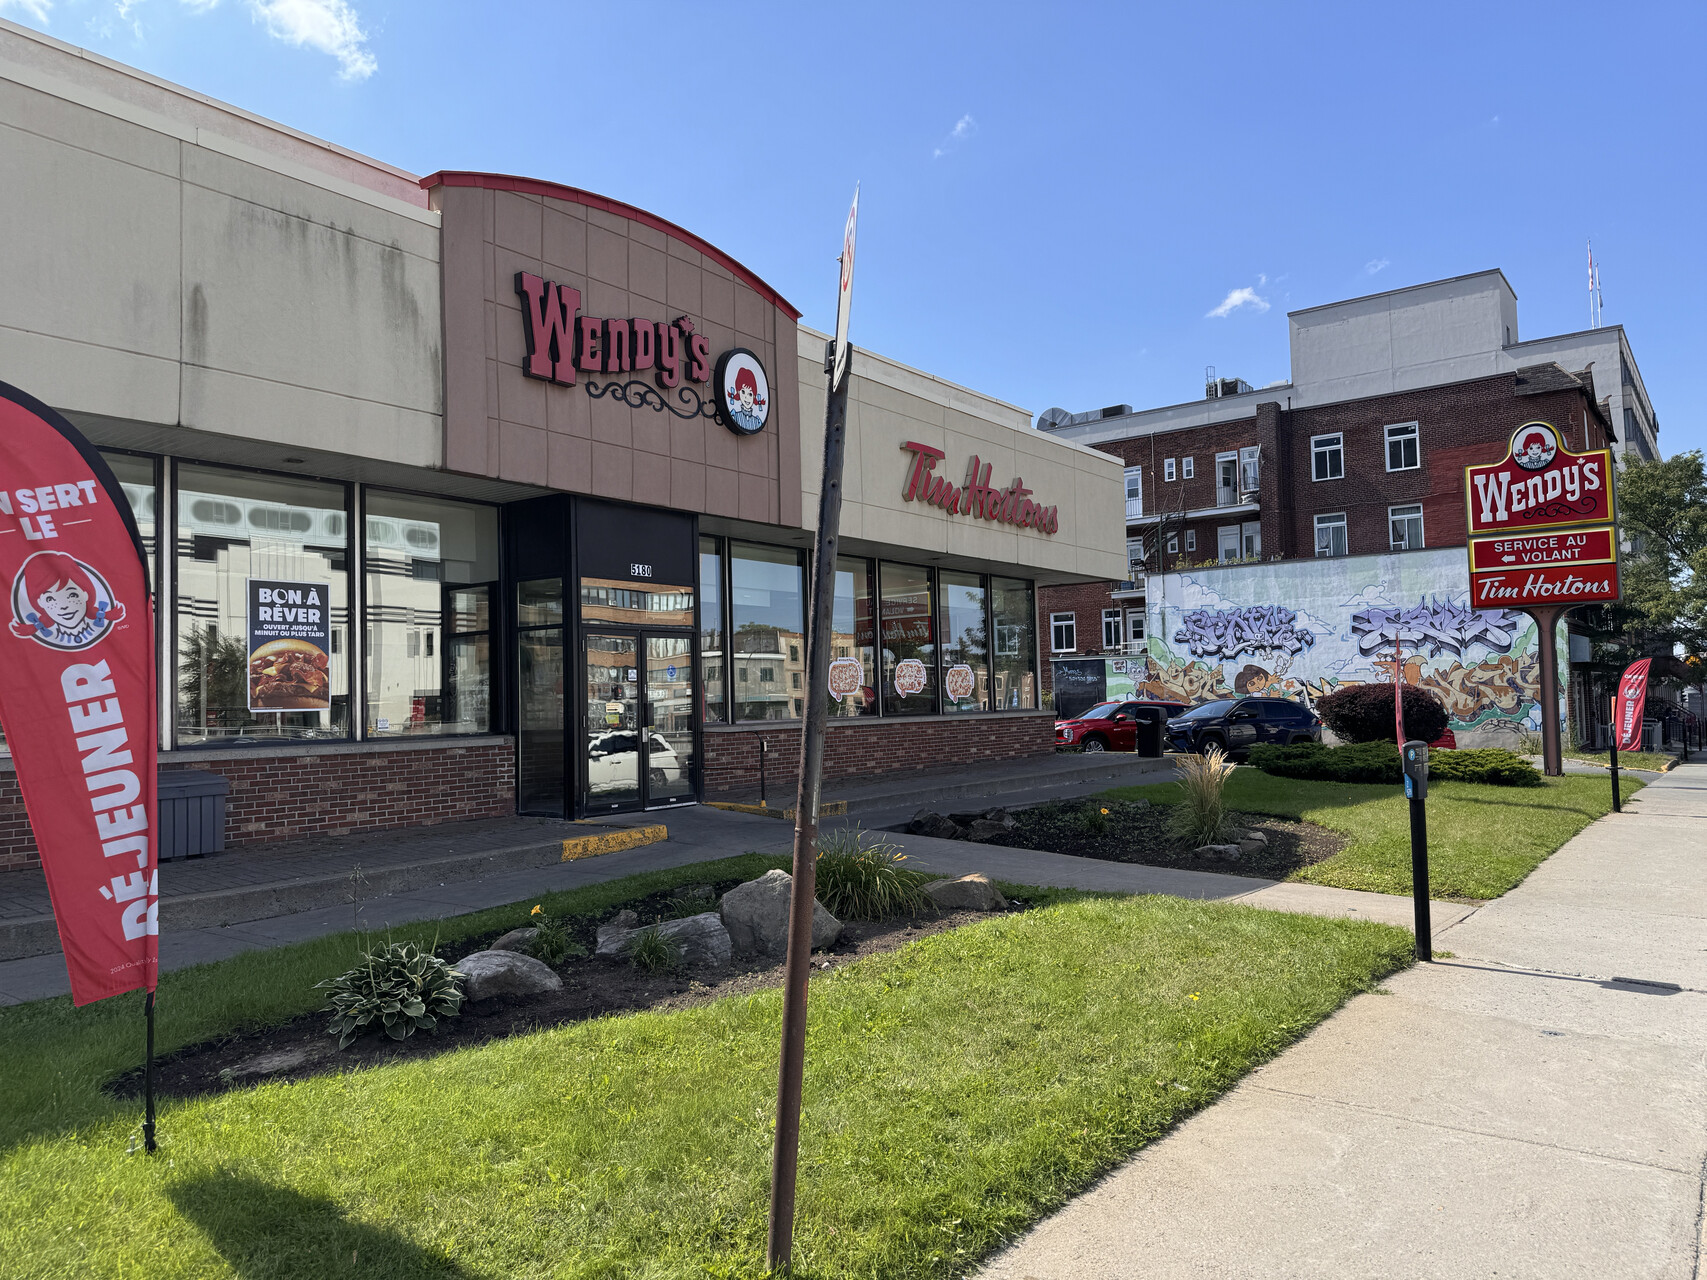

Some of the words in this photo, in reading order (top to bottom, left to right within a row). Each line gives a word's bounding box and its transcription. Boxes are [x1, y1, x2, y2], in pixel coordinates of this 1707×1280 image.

[0, 490, 14, 515] N
[15, 479, 98, 514] SERT
[900, 440, 962, 515] Tim
[960, 454, 1059, 535] Hortons
[18, 514, 59, 541] LE
[1494, 537, 1558, 553] SERVICE
[1566, 535, 1587, 546] AU
[1521, 548, 1581, 563] VOLANT
[631, 564, 651, 576] 5180
[259, 588, 302, 604] BON
[306, 587, 321, 606] À
[1477, 576, 1519, 601] Tim
[1522, 573, 1610, 598] Hortons
[259, 604, 320, 622] RÊVER
[1621, 701, 1634, 744] DÉJEUNER
[60, 658, 159, 943] DÉJEUNER
